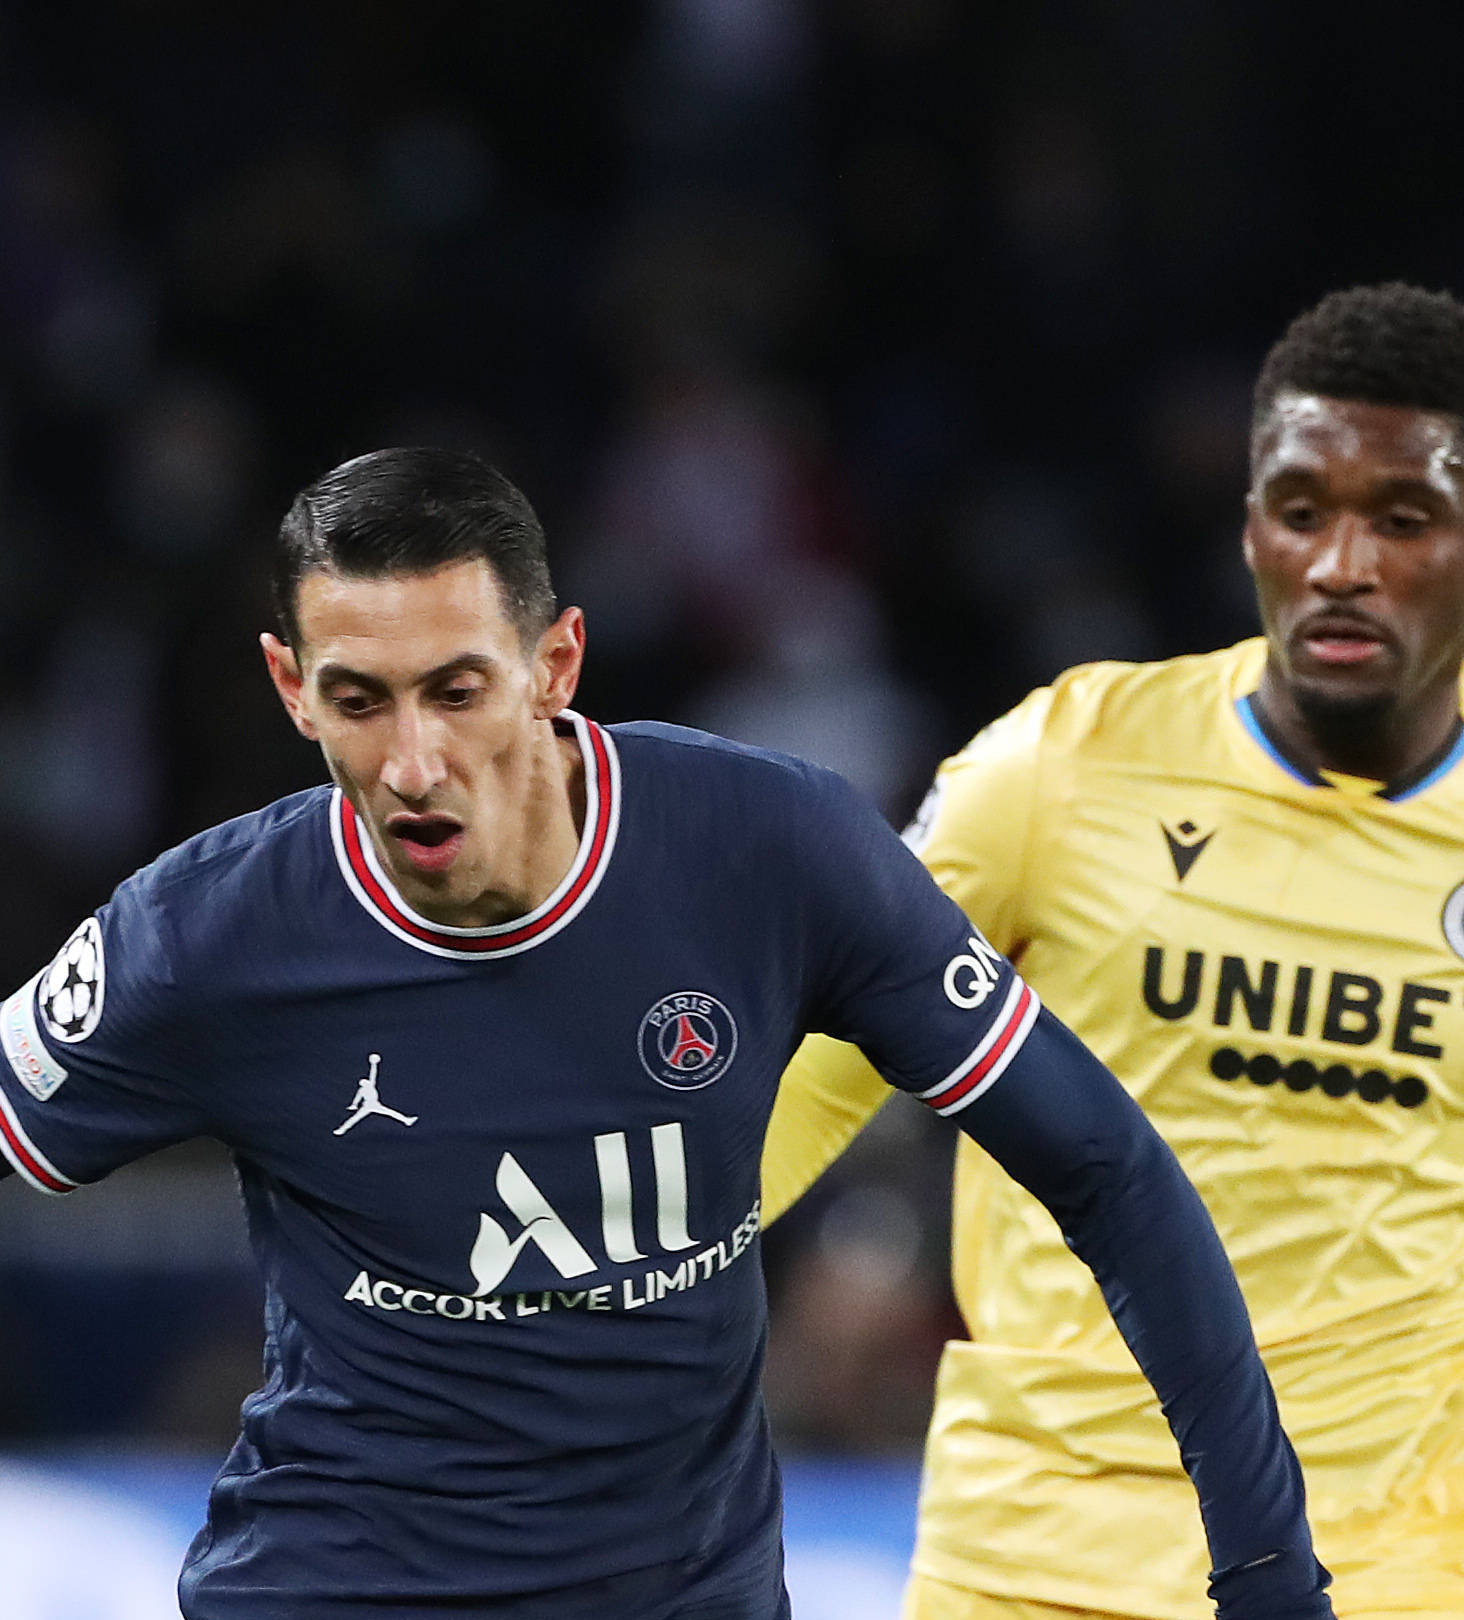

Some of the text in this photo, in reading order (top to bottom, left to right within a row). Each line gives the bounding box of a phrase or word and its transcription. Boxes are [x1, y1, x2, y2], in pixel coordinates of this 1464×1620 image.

[648, 996, 715, 1028] PARIS
[343, 1270, 507, 1321] ACCOR
[516, 1284, 613, 1317] LIVE
